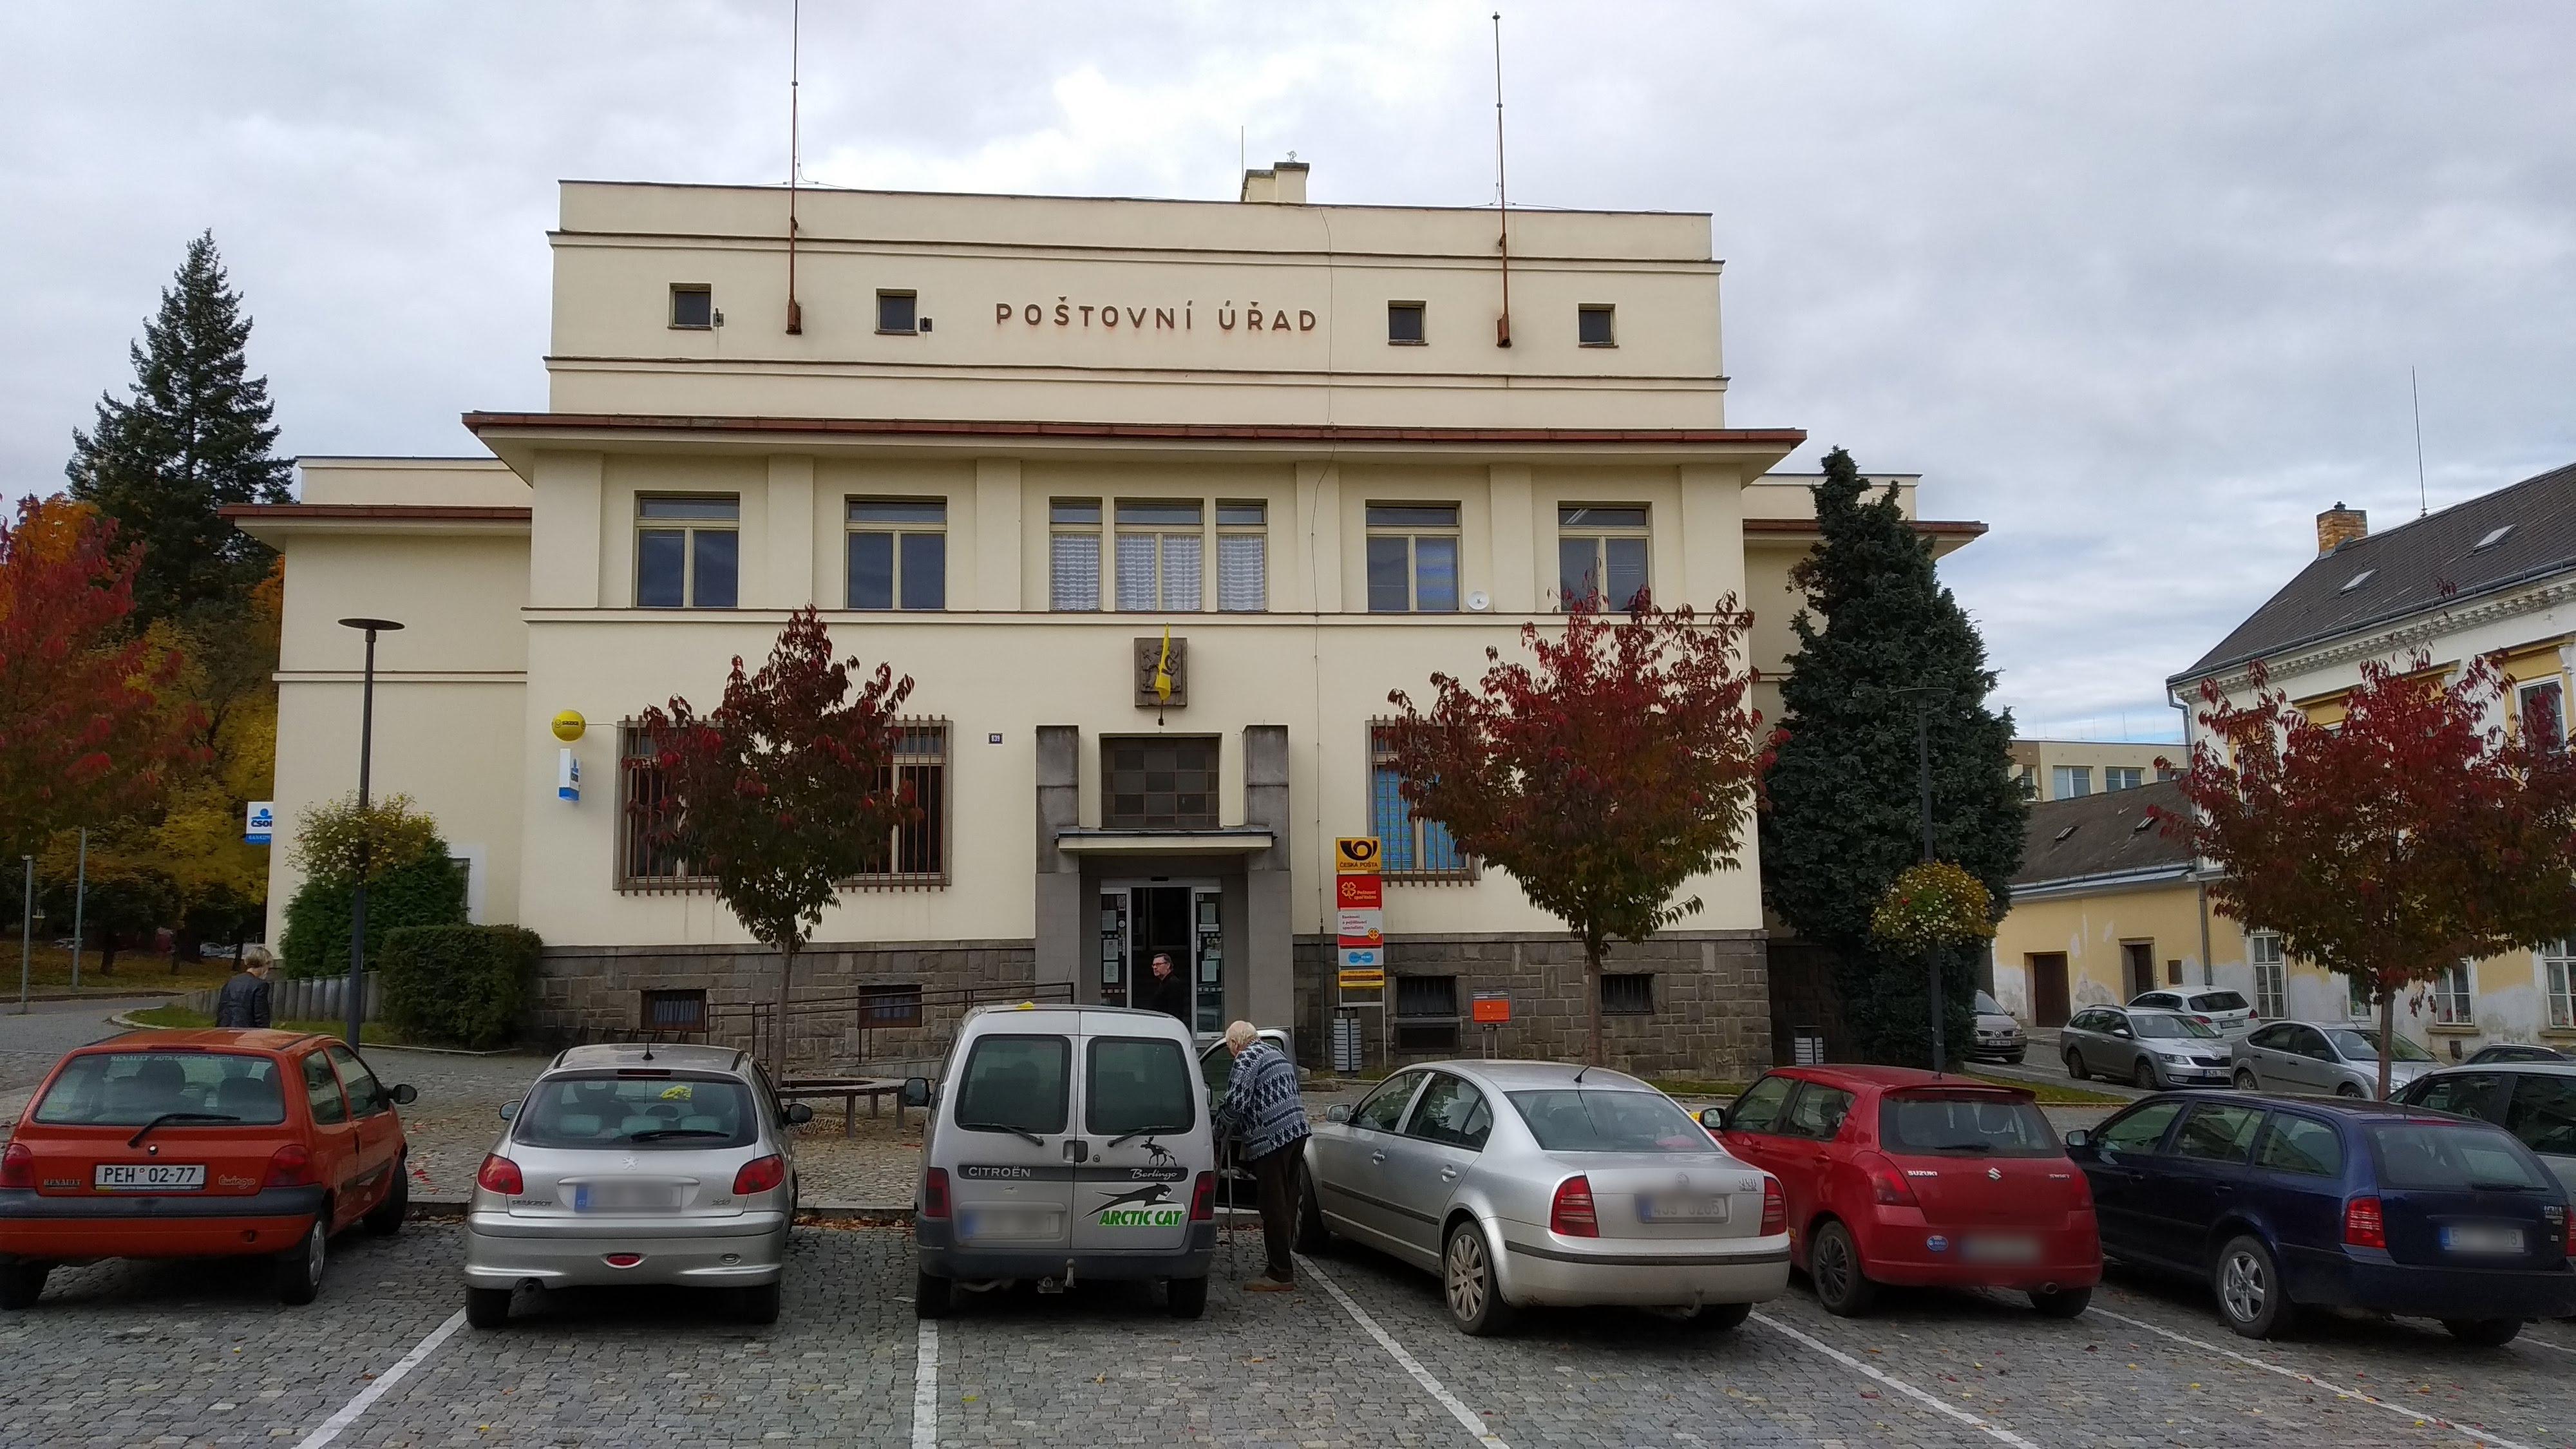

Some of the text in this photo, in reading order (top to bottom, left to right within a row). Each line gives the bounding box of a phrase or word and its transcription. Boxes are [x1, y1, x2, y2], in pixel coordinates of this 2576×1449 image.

[996, 296, 1316, 331] POŠTOVNÍ ÚŘAD
[104, 1167, 196, 1184] PEH 02-77
[968, 1165, 1178, 1180] CITROËN Berlingo
[43, 1179, 82, 1187] RENAULT
[218, 1174, 256, 1189] twingo
[512, 1199, 553, 1208] PEUGEOT
[1099, 1210, 1183, 1226] ARCTIC CAT
